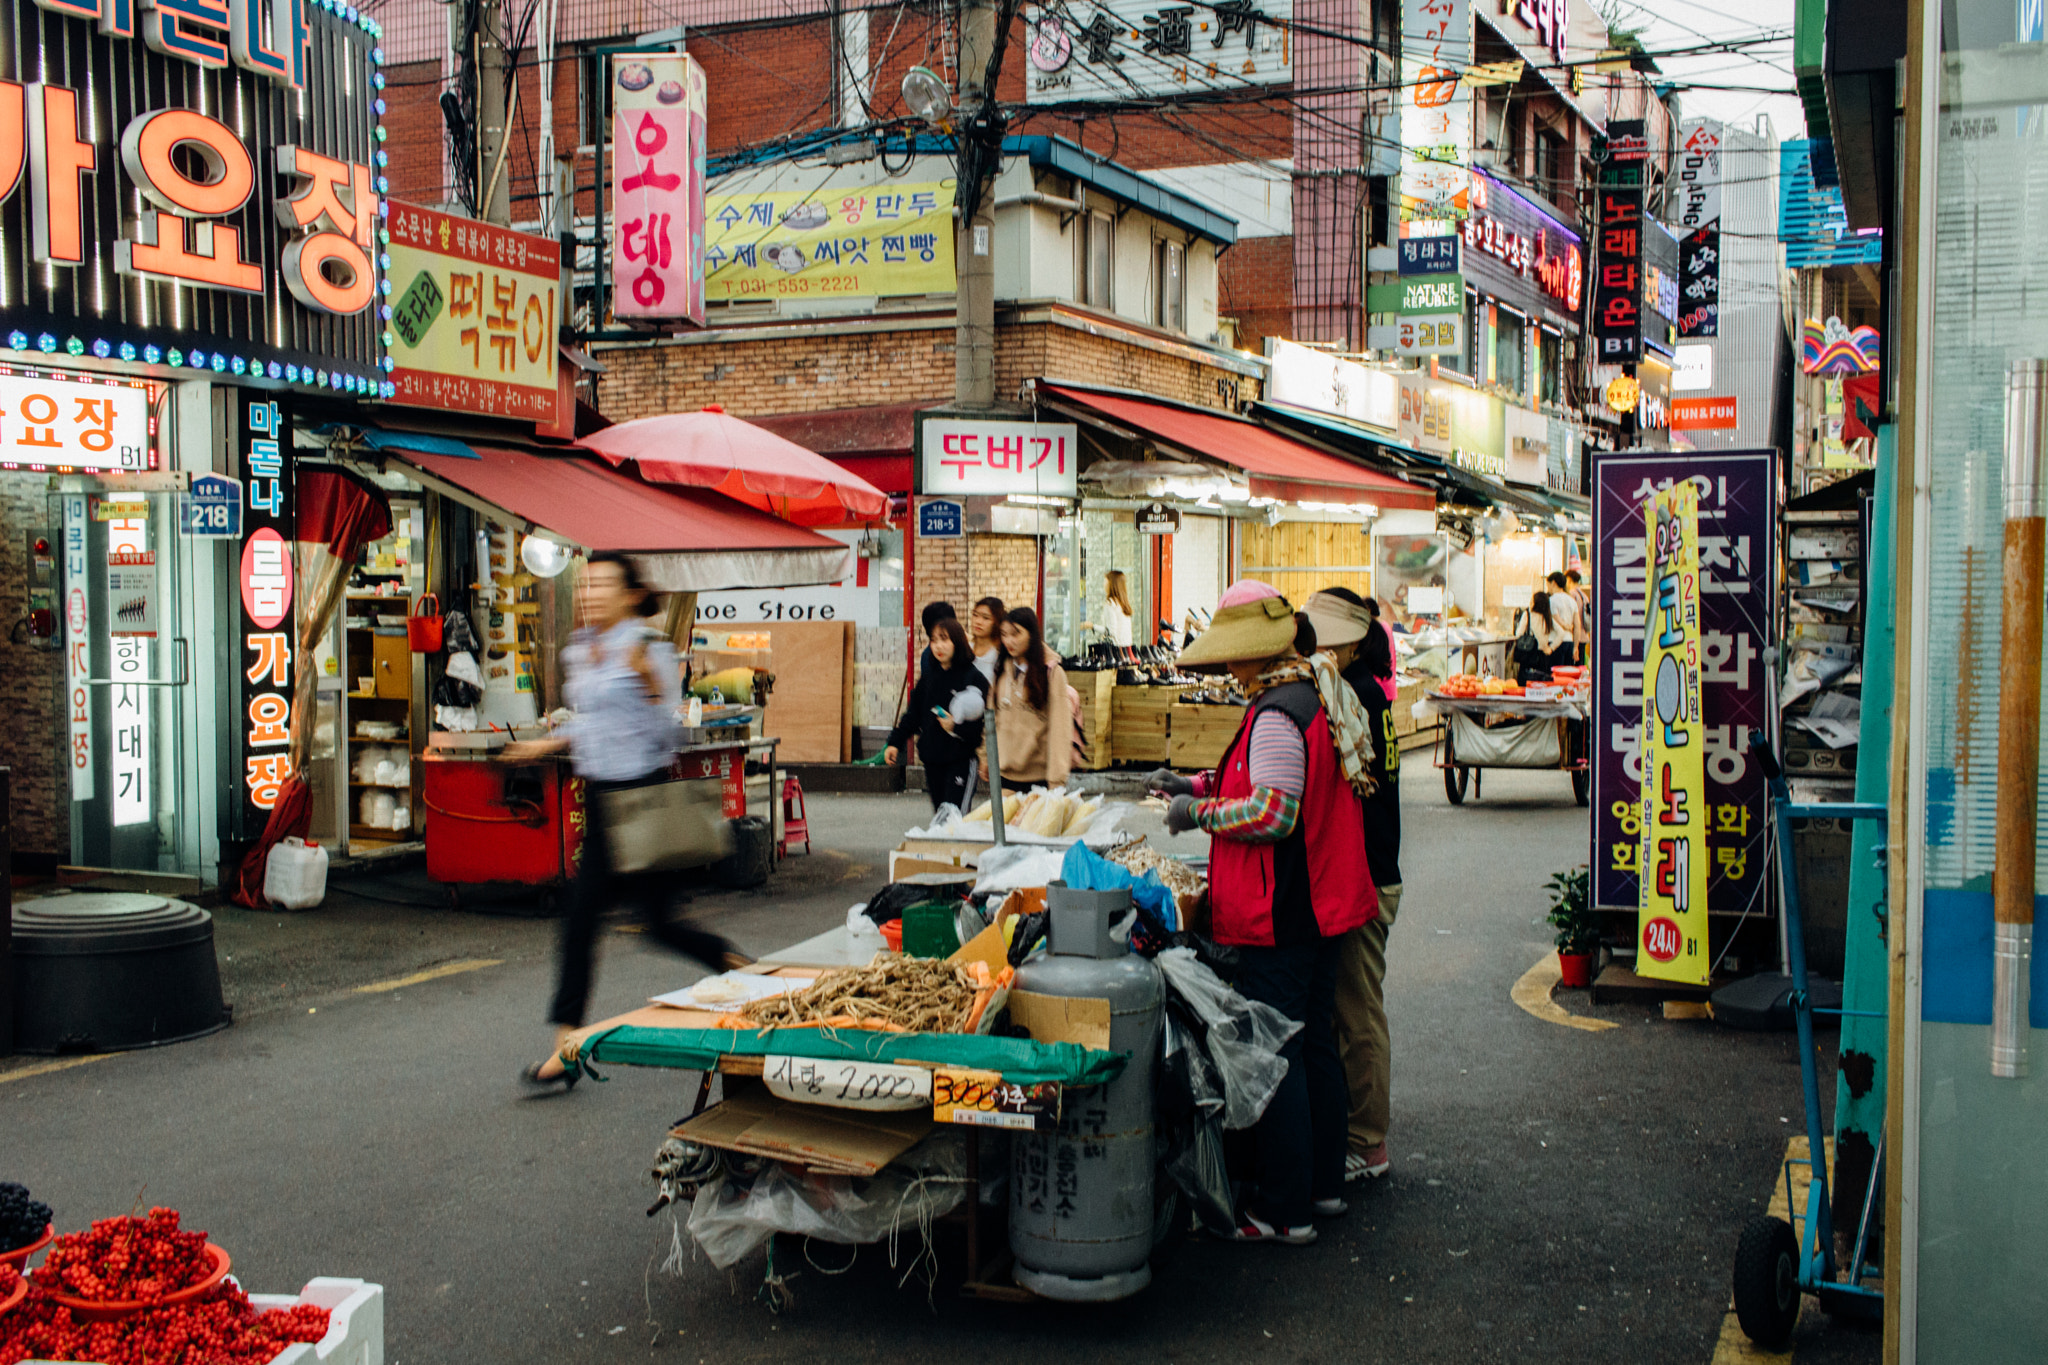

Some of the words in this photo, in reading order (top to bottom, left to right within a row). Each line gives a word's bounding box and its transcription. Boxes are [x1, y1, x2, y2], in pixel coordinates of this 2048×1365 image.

[621, 110, 681, 307] 오뎅
[715, 201, 774, 231] 수제
[395, 210, 433, 245] 소문난
[456, 225, 490, 260] 떡볶이
[705, 244, 757, 269] 수제
[814, 236, 871, 266] 씨앗
[881, 233, 938, 264] 찐빵
[1603, 196, 1639, 327] 노래타운
[1403, 293, 1460, 309] REPUBLIC
[1406, 282, 1456, 298] NATURE
[449, 270, 555, 379] 떡볶이
[1418, 321, 1456, 348] 김밥
[1605, 337, 1634, 353] B1
[0, 393, 118, 452] 요장
[1673, 405, 1735, 421] FUN&FUN
[120, 446, 142, 467] B1
[248, 400, 283, 518] 마돈나
[940, 433, 1065, 481] 뚜버기
[191, 504, 229, 528] 218
[926, 518, 954, 531] 218-5
[249, 539, 286, 617] 룸
[759, 600, 836, 620] Store
[1683, 573, 1696, 630] 2곡
[1686, 640, 1699, 725] 5백원
[247, 633, 292, 811] 가요장
[1649, 922, 1676, 956] 24시
[1687, 938, 1698, 956] B1
